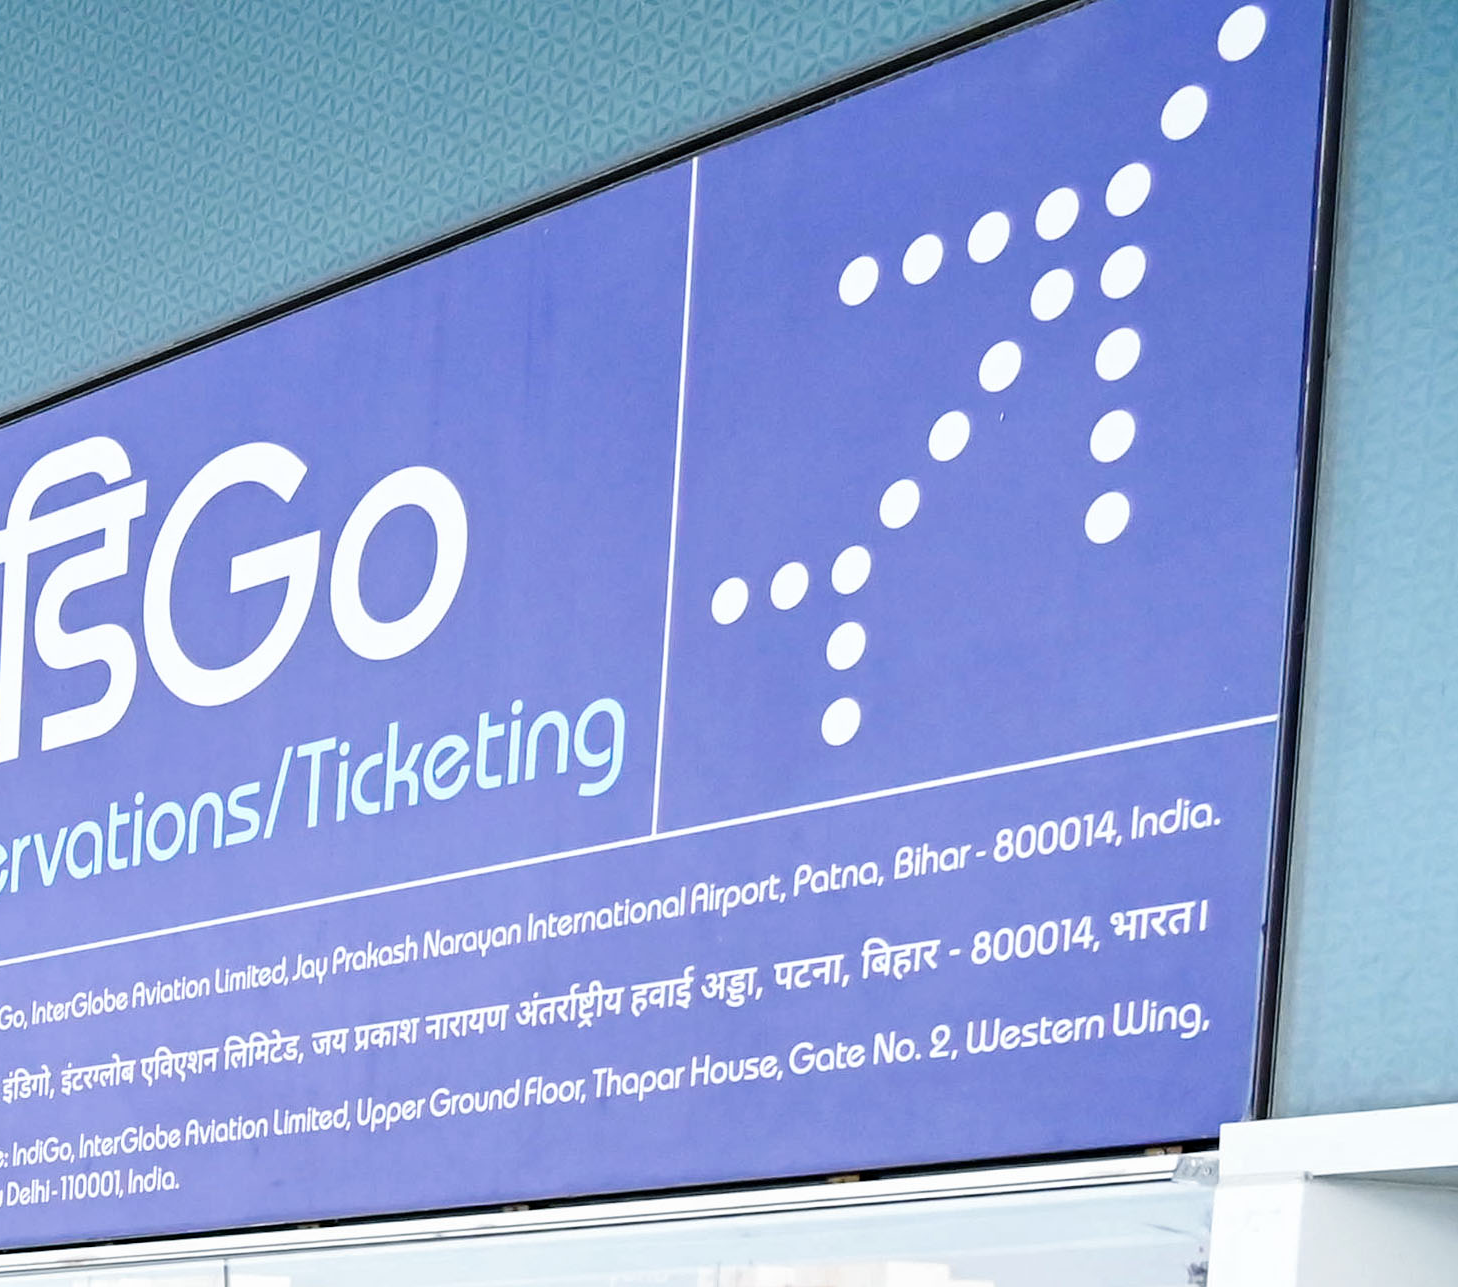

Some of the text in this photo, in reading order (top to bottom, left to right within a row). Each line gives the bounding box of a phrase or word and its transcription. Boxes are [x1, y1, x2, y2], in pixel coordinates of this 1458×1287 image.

[31, 988, 128, 1026] InterGlobe
[131, 974, 211, 1007] Aviation
[214, 956, 289, 994] Limited,
[292, 953, 328, 982] Jay
[331, 934, 418, 975] Prakash
[422, 923, 522, 959] Narayan
[527, 886, 686, 942] International
[690, 874, 786, 917] Airport,
[793, 863, 884, 897] Patna,
[893, 843, 972, 881] Bihar
[993, 810, 1122, 862] 800014,
[1130, 798, 1221, 840] India.
[2, 1064, 55, 1100] इंडिगो,
[61, 1053, 136, 1096] इंटरग्लोब
[140, 1047, 218, 1088] एविएशन
[224, 1028, 304, 1071] लिमिटेड,
[312, 1028, 349, 1058] जय
[353, 1017, 421, 1053] प्रकाश
[424, 1004, 510, 1041] नारायण
[630, 965, 695, 1017] हवाई
[700, 967, 764, 1008] अड्डा,
[774, 954, 850, 991] पटना,
[862, 937, 941, 980] बिहार
[970, 915, 1100, 965] 800014,
[12, 1136, 75, 1168] IndiGo,
[78, 1120, 181, 1159] InterGlobe
[185, 1111, 268, 1145] Aviation
[273, 1100, 352, 1136] Limited,
[356, 1097, 426, 1133] Upper
[429, 1079, 521, 1117] Ground
[524, 1075, 586, 1106] Floor,
[592, 1064, 686, 1102] Thapar
[690, 1055, 784, 1087] House,
[788, 1041, 866, 1076] Gate
[873, 1030, 922, 1065] No.
[929, 1024, 959, 1061] 2,
[966, 1015, 1105, 1054] Western
[1112, 999, 1211, 1039] Wing,
[127, 1166, 180, 1194] India.
